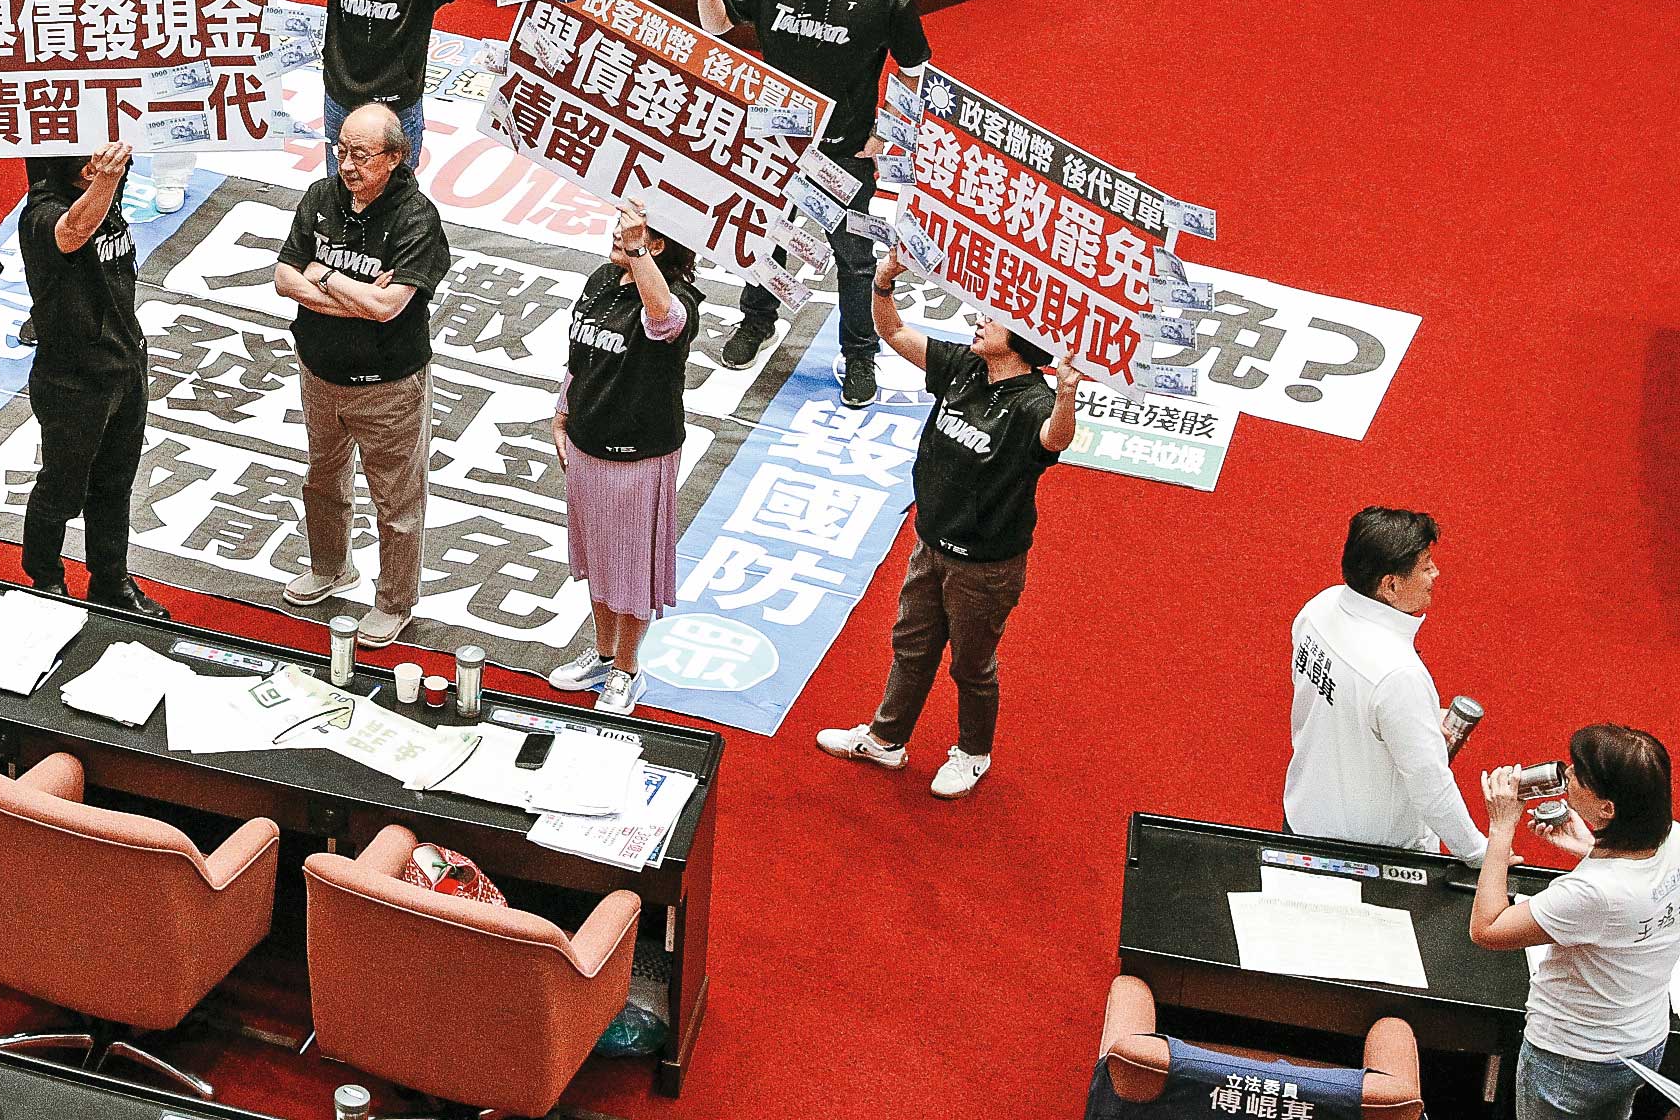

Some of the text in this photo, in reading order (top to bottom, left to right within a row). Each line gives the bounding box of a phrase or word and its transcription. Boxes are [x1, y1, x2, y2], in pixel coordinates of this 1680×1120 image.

[489, 76, 766, 269] 債留下一代
[518, 1, 800, 198] 舉債發現金
[959, 96, 1164, 234] 政客撒幣 後代買單
[917, 120, 1153, 307] 發錢救罷免
[677, 398, 929, 626] 毀國防
[1387, 866, 1423, 881] 009
[1226, 1073, 1299, 1099] 立法委員
